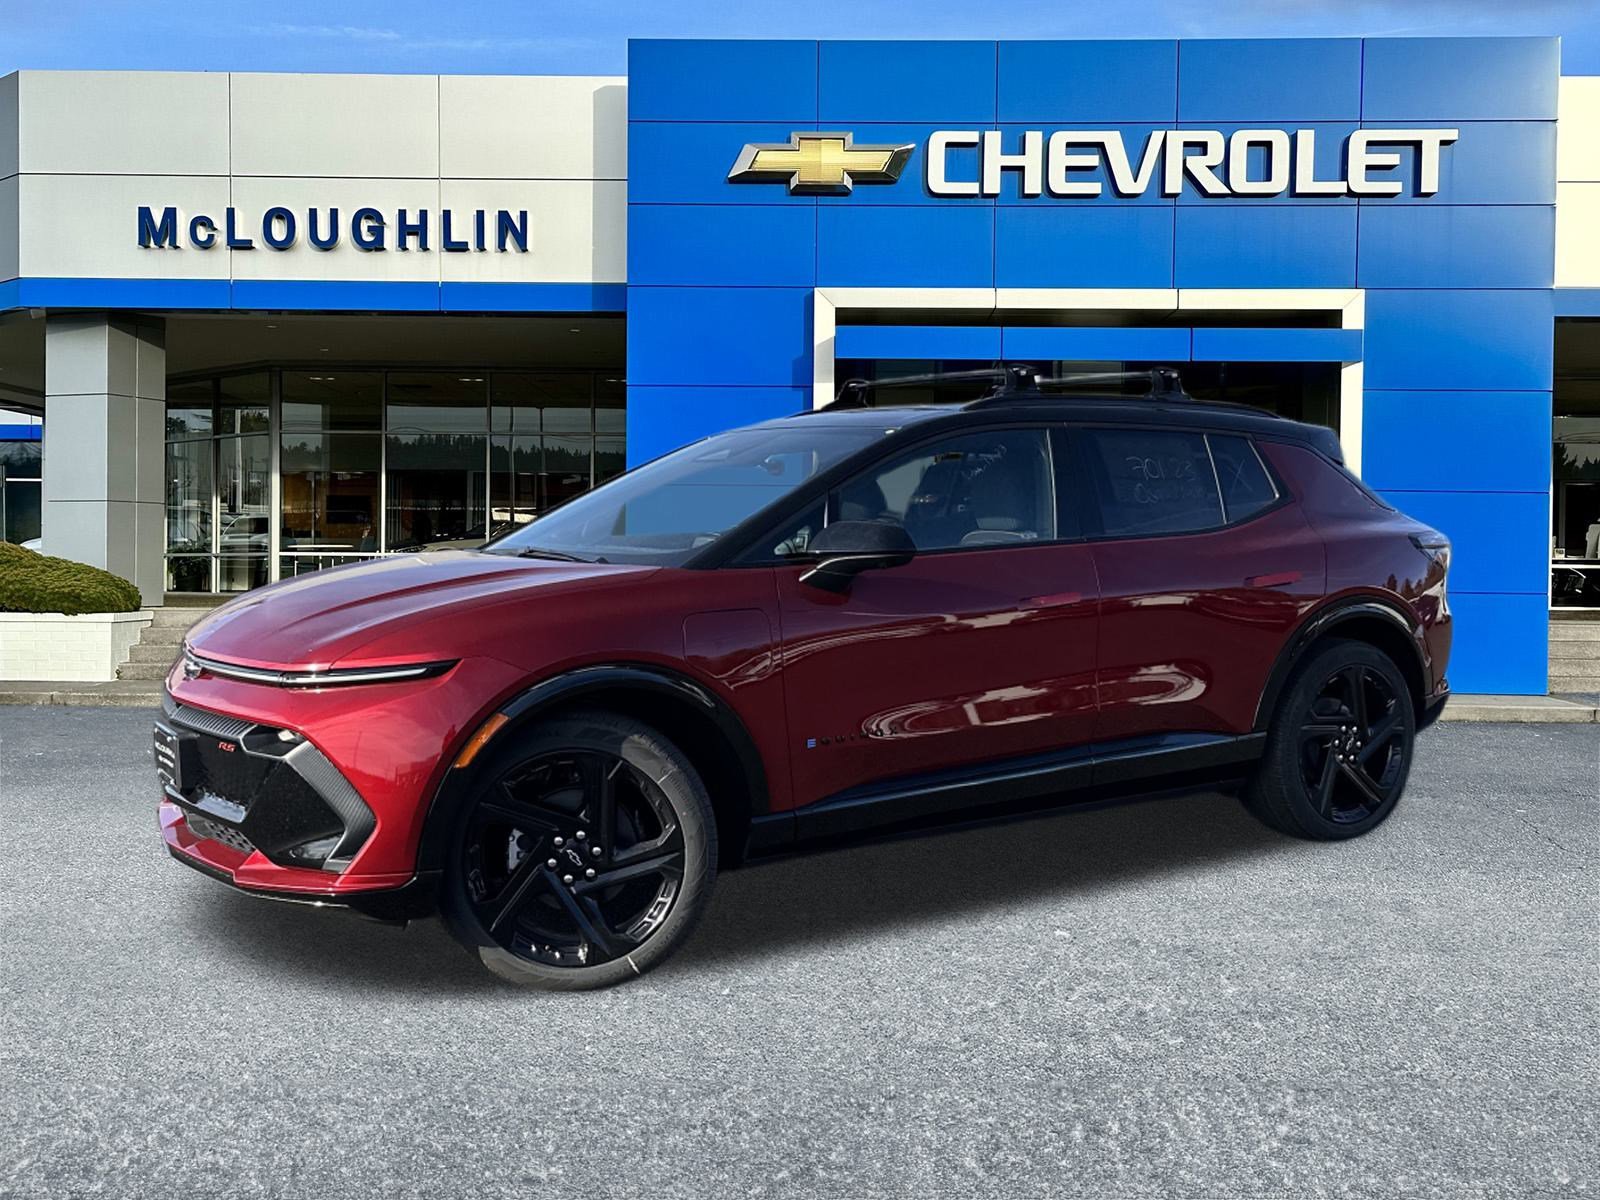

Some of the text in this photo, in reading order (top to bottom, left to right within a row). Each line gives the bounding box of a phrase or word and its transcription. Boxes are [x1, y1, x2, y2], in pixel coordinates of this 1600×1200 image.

[927, 128, 1458, 196] CHEVROLET
[138, 206, 529, 252] McLOUGHLIN
[218, 741, 235, 752] RS
